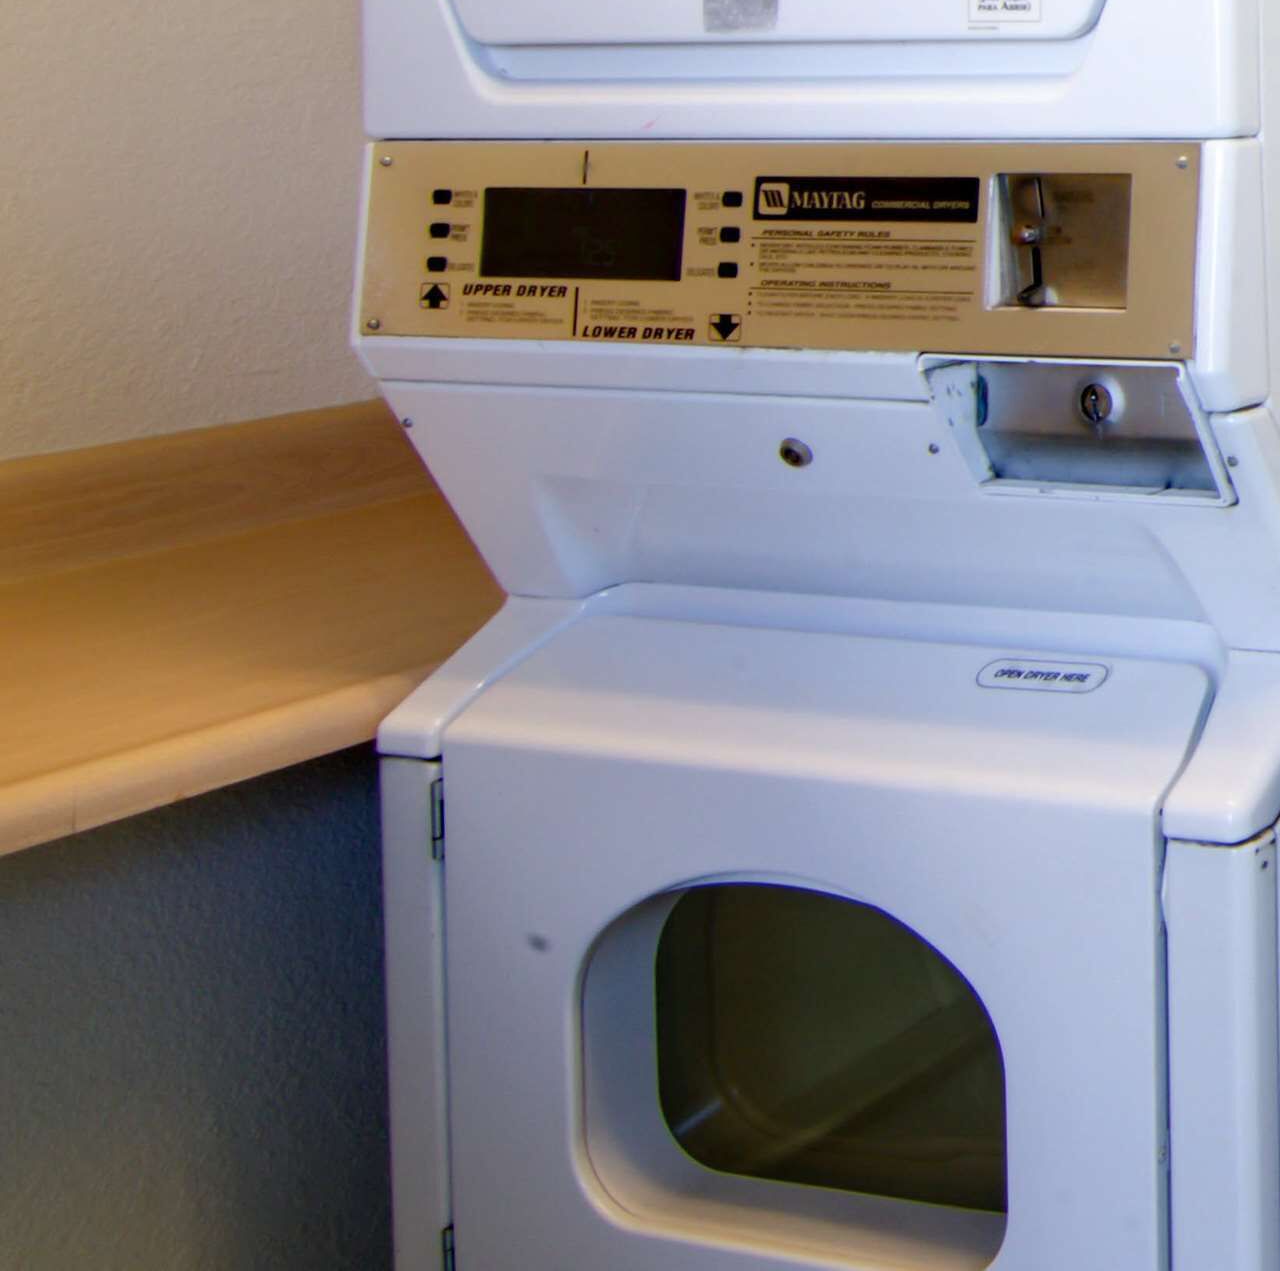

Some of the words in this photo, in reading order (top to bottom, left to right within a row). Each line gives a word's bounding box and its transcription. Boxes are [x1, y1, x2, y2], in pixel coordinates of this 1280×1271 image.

[791, 191, 866, 209] MAYTAG
[871, 200, 931, 210] COMMERCIAL
[932, 201, 971, 210] DRYERS
[463, 283, 512, 296] UPPER
[516, 284, 568, 297] DRYER
[582, 325, 637, 339] LOWER
[642, 327, 695, 340] DRYER
